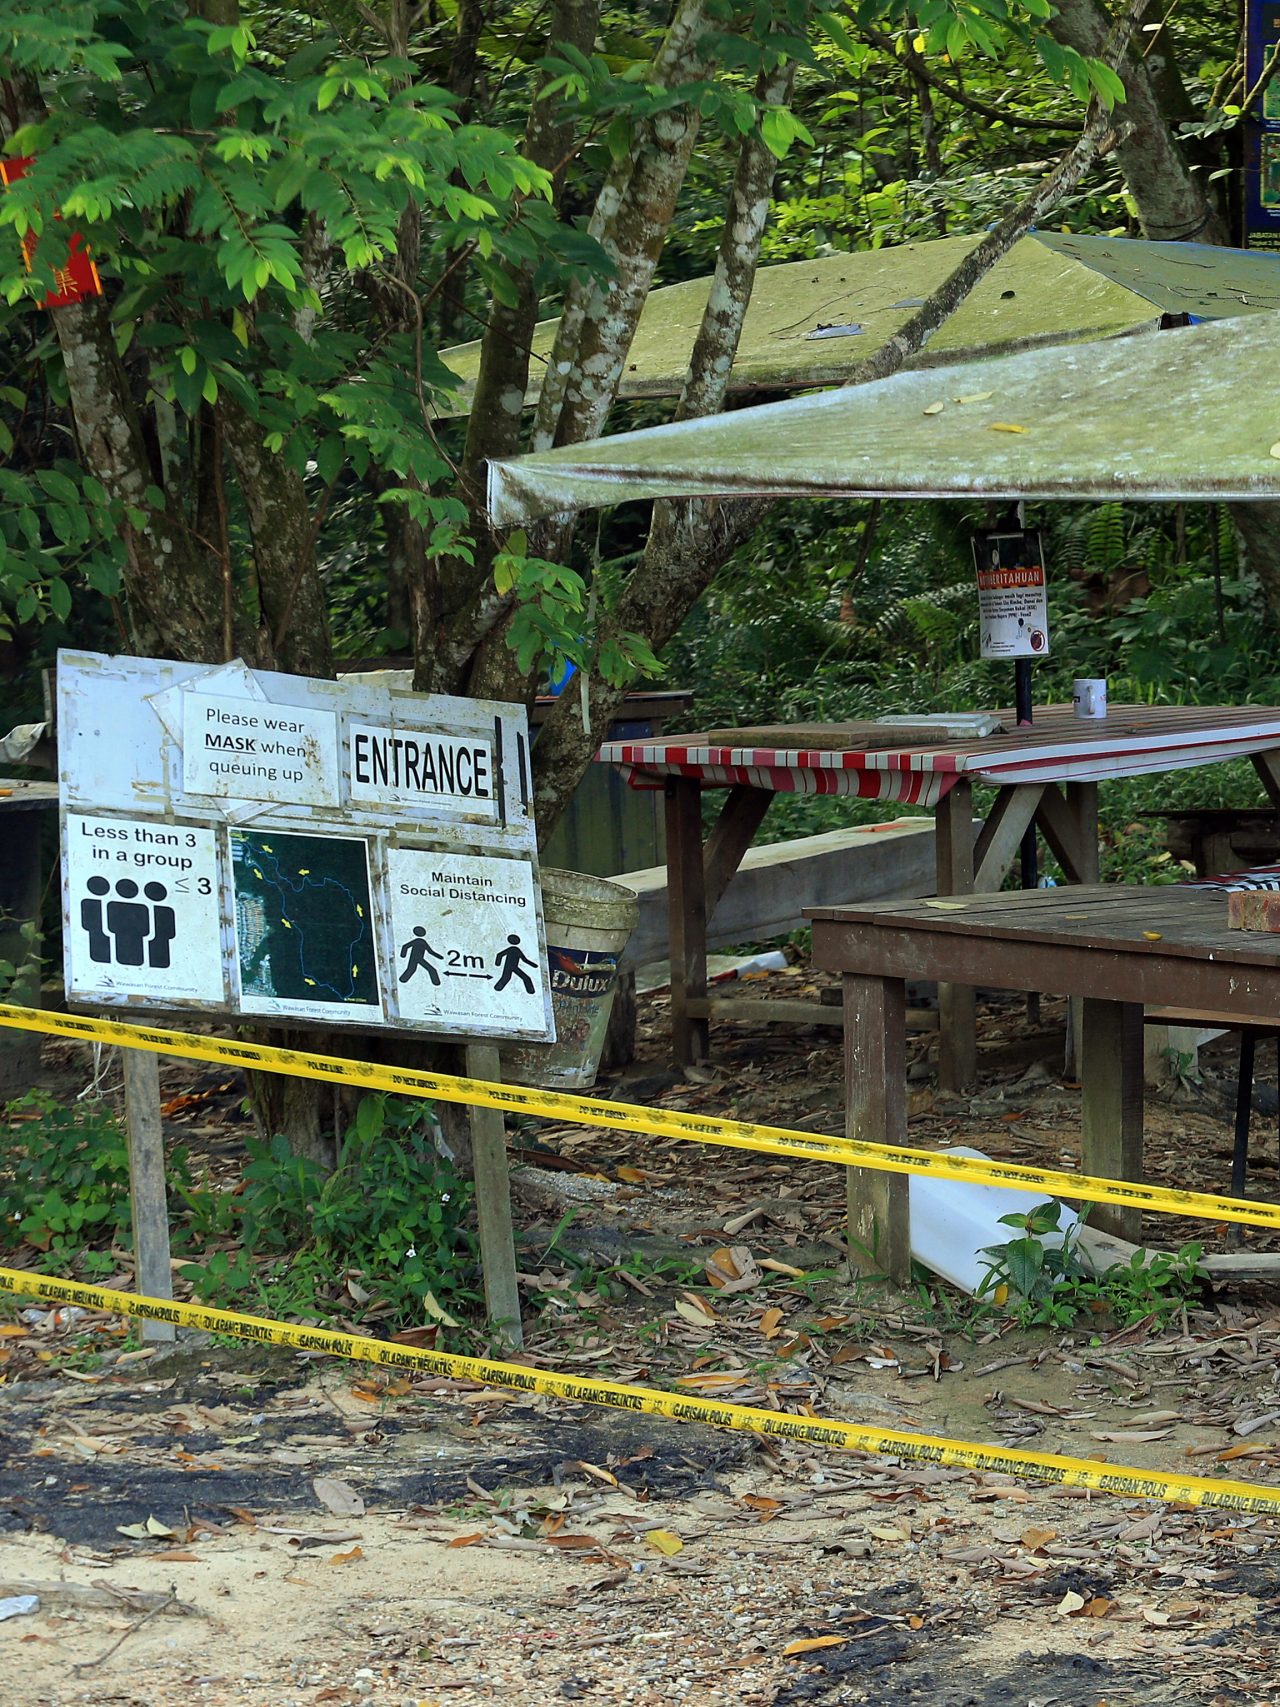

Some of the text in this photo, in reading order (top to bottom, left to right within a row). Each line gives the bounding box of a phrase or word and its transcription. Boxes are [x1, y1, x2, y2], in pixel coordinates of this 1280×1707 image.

[979, 571, 1040, 586] ERITAHUAN
[206, 708, 305, 734] Please wear
[205, 733, 306, 758] MASK when
[209, 760, 304, 783] queuing up
[355, 734, 489, 798] ENTRANCE
[82, 822, 197, 848] Less than 3
[92, 845, 192, 871] in a group
[197, 878, 212, 895] 3
[432, 872, 493, 887] Maintain
[400, 884, 527, 908] Social Distancing
[447, 950, 485, 970] 2m
[552, 969, 609, 992] Dulux
[282, 1004, 351, 1016] Wawasan Forest Community
[443, 1009, 470, 1017] Wawasan
[480, 1367, 536, 1390] GARISAN POLIS
[565, 1384, 643, 1410] DILARANG MELINTAS
[672, 1403, 734, 1426] GARISAN POLIS
[764, 1420, 848, 1446] DILARANG MELINTAS
[879, 1438, 945, 1462] GARISAN POLIS
[976, 1453, 1066, 1482] DILARANG MELINTAS
[1099, 1474, 1168, 1498] GARISAN POLIS
[1202, 1491, 1250, 1512] DILARANG
